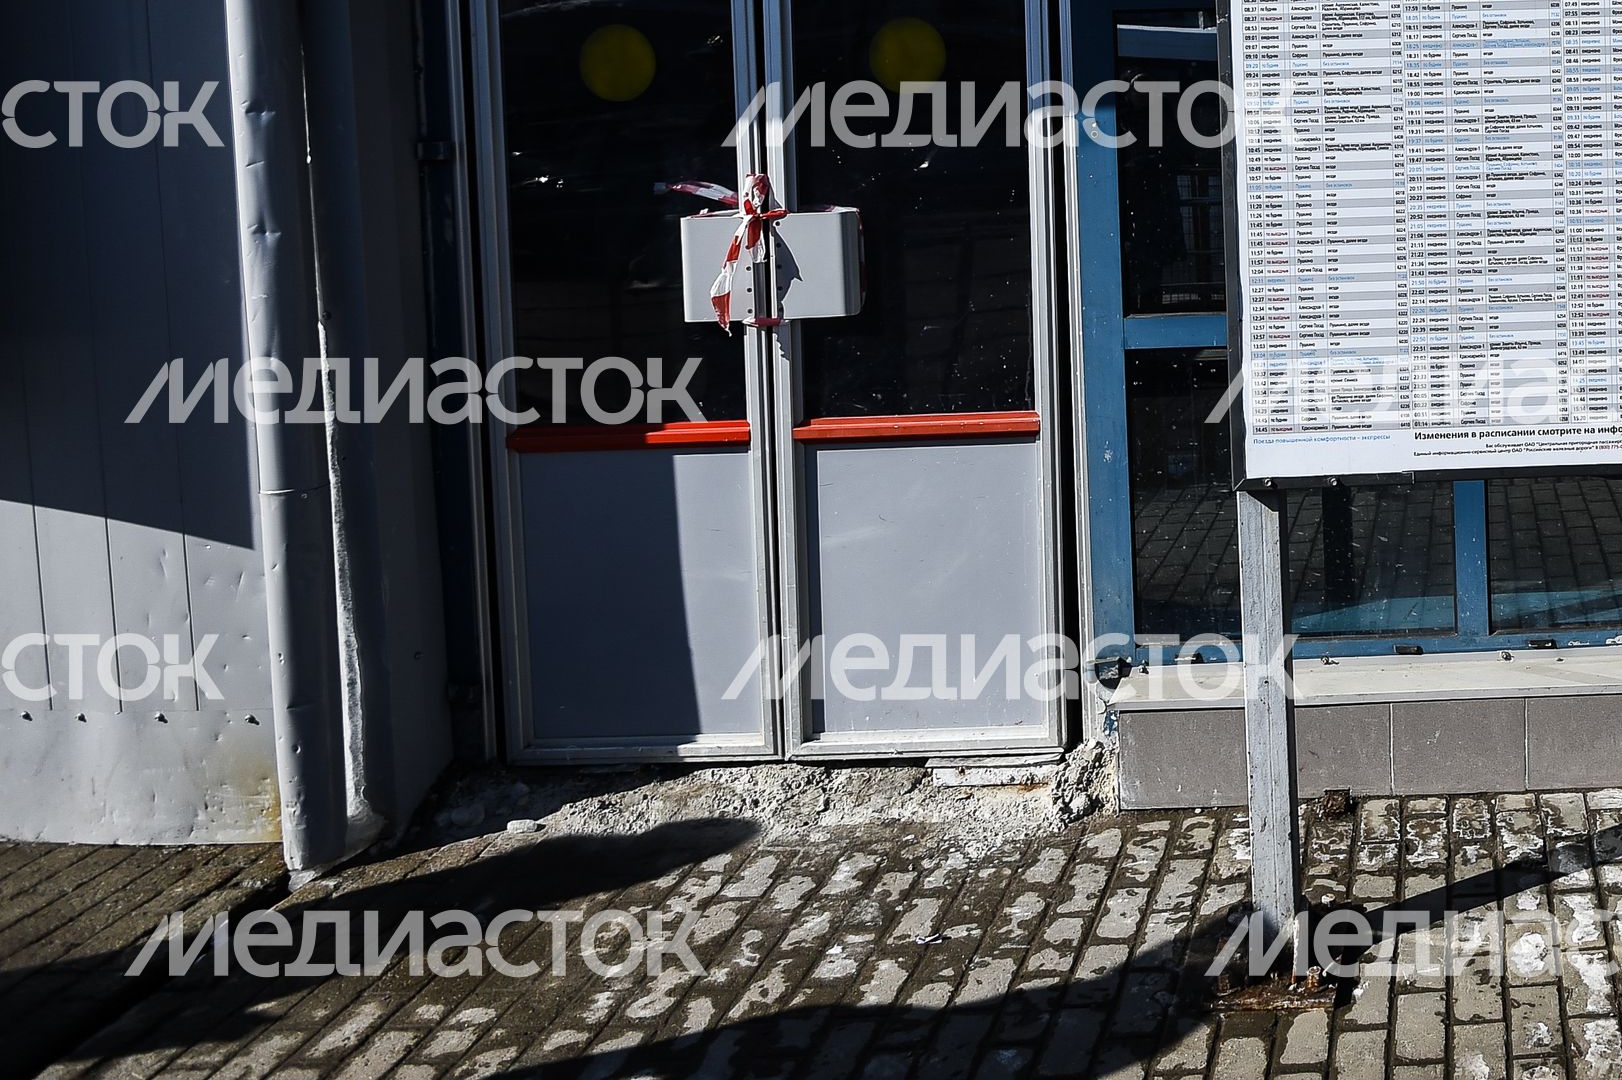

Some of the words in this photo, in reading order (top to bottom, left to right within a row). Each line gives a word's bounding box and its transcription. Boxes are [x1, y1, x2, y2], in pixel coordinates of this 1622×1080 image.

[1414, 431, 1469, 441] Изменения
[1479, 429, 1535, 440] расписании
[1537, 427, 1582, 438] смотрите
